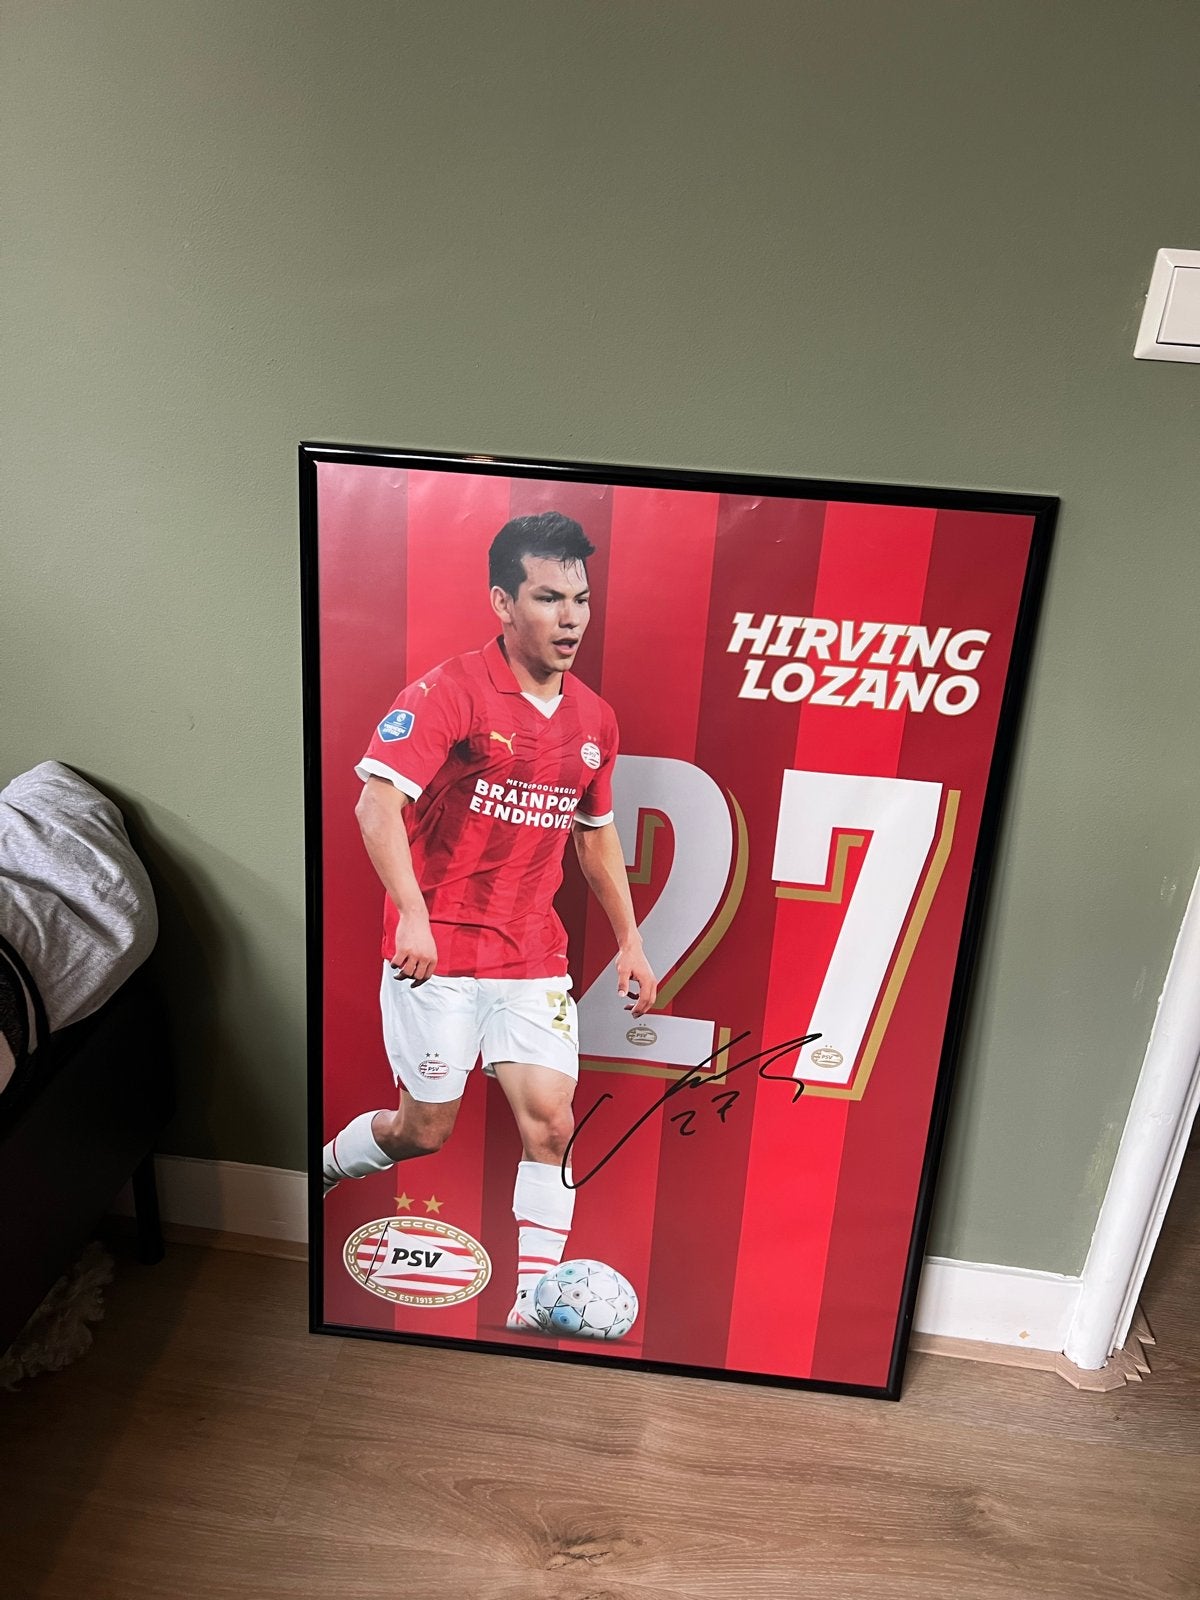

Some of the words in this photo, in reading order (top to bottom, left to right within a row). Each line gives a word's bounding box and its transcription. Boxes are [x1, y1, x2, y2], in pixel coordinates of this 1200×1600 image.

[726, 611, 992, 671] HIRVING
[738, 659, 981, 716] LOZANO
[474, 778, 580, 812] BRAINPOR
[506, 778, 577, 795] METROPOOLREGIO
[578, 754, 945, 1085] 27
[391, 1247, 443, 1269] PSV
[400, 1294, 414, 1303] EST
[415, 1296, 433, 1305] 1913
